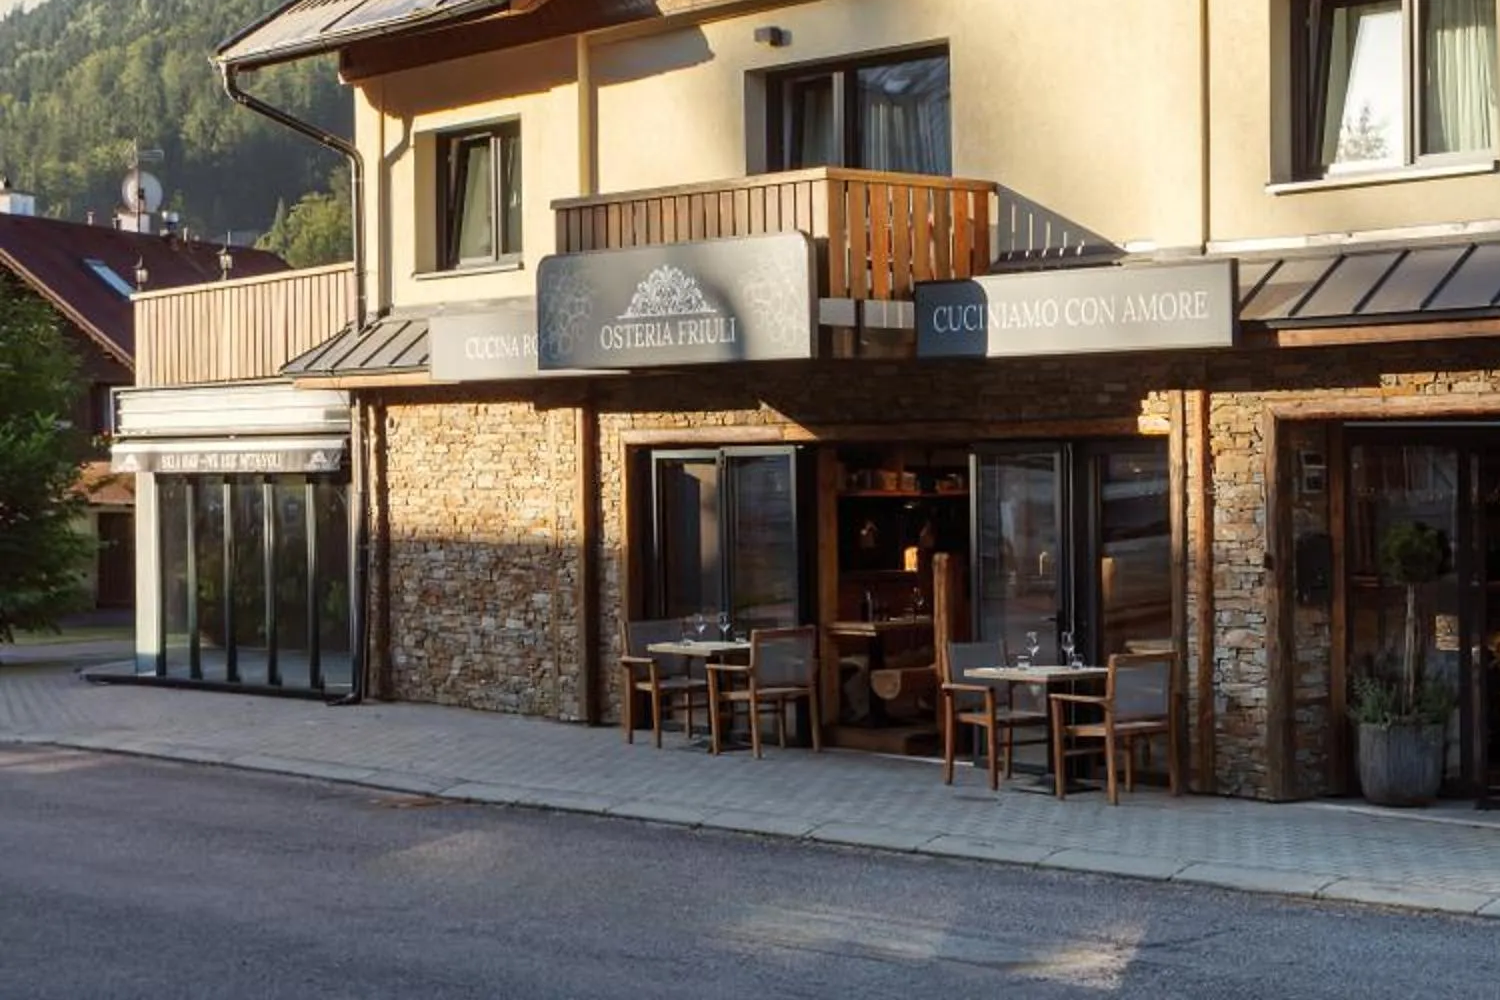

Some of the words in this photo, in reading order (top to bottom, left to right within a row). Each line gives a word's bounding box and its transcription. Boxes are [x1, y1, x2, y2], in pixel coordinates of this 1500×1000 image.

[932, 298, 1060, 334] CUCINIAMO
[1065, 297, 1116, 327] CON
[1121, 290, 1211, 324] AMORE
[465, 335, 519, 359] CUCINA
[600, 321, 676, 351] OSTERIA
[677, 316, 737, 347] FRIULI
